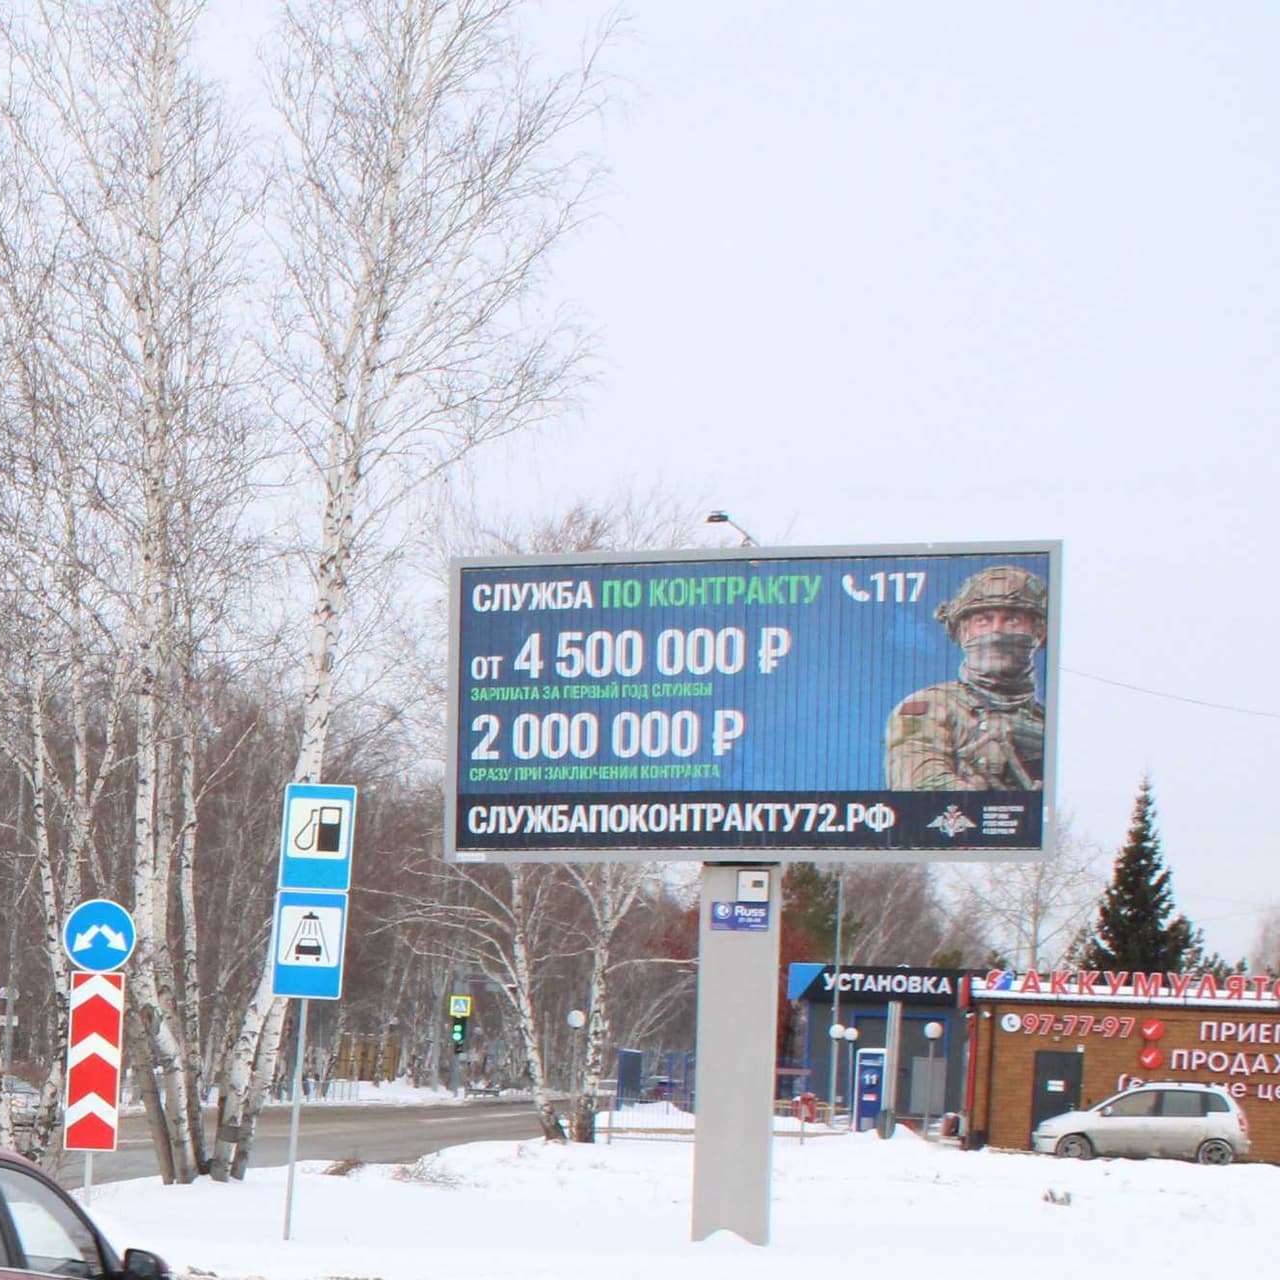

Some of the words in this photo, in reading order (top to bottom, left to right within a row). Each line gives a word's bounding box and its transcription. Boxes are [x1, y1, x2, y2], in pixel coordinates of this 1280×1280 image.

[472, 580, 593, 612] СЛУЖБА
[601, 578, 642, 609] ПО
[649, 575, 822, 607] КОНТРАКТУ
[870, 572, 926, 602] 117
[514, 632, 544, 679] 4
[555, 629, 643, 678] 500
[657, 627, 746, 676] 000
[471, 686, 540, 701] ЗАРПЛАТА
[543, 686, 560, 700] ЗА
[563, 682, 619, 699] ПЕРВЫЙ
[622, 683, 648, 699] ГОД
[652, 682, 713, 697] СЛУЖБЫ
[471, 714, 500, 760] 2
[512, 712, 599, 759] 000
[612, 710, 699, 758] 000
[469, 767, 511, 781] СРАЗУ
[515, 766, 542, 781] ПРИ
[545, 765, 638, 780] ЗАКЛЮЧЕНИИ
[641, 763, 720, 779] КОНТРАКТА
[468, 802, 895, 834] СЛУЖБАПОКОНТРАКТУ72.РФ
[734, 905, 767, 917] Russ
[823, 973, 952, 995] УСТАНОВКА
[1023, 1012, 1136, 1039] 97-77-97
